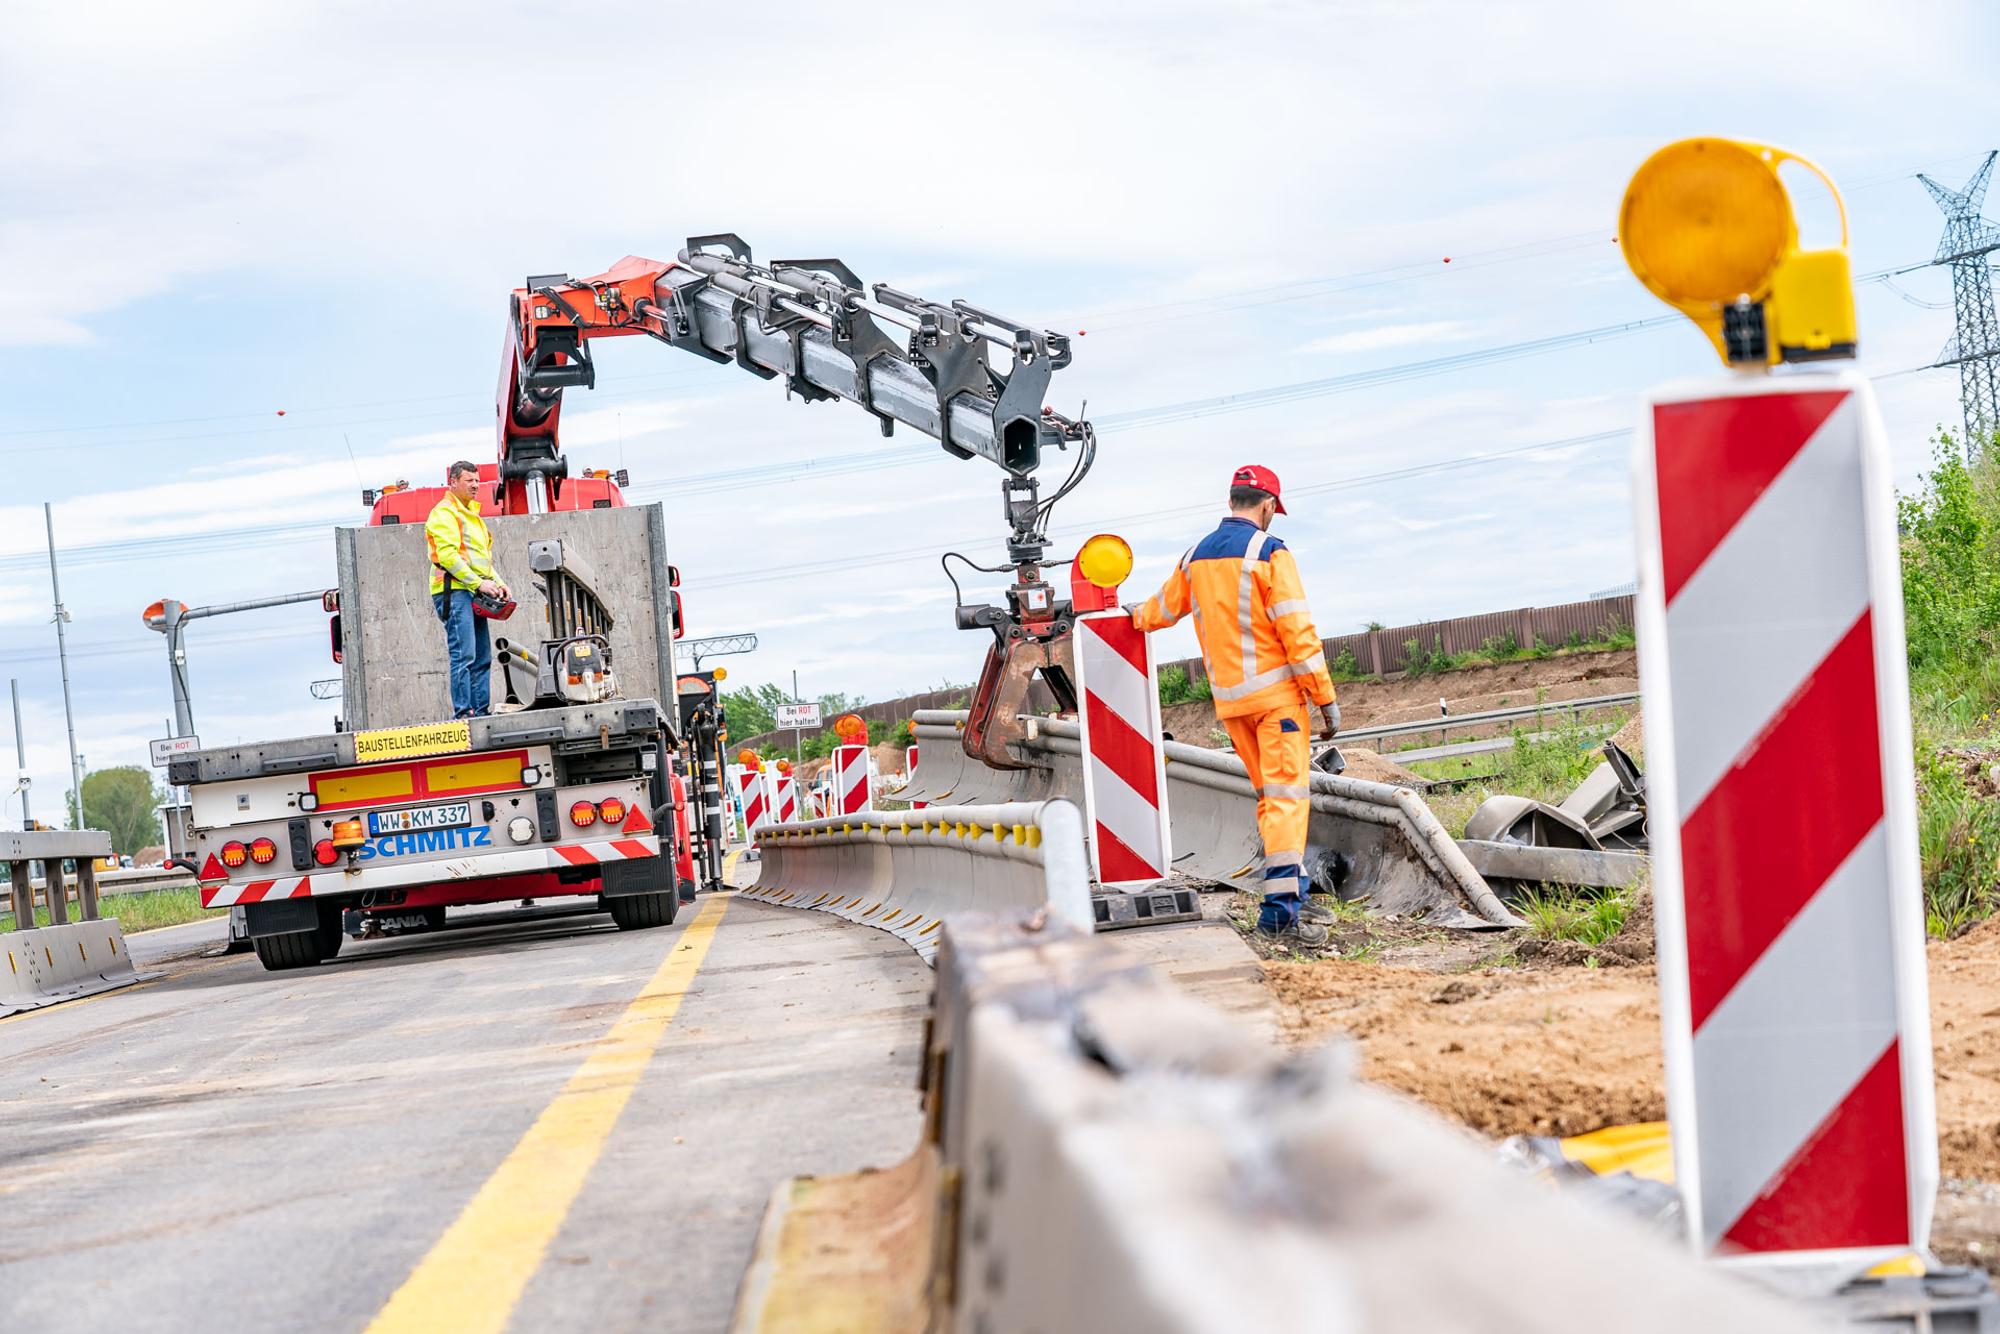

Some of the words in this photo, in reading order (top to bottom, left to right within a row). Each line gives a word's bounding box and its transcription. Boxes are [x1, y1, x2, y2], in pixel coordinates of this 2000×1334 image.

[786, 706, 797, 715] Bei
[798, 705, 812, 714] ROT
[794, 716, 819, 726] halten!
[175, 741, 190, 750] ROT
[357, 729, 468, 754] BAUSTELLENFAHRZEUG
[379, 813, 400, 831] WW
[411, 810, 433, 828] KM
[437, 805, 467, 824] 337
[358, 825, 492, 860] SCHMITZ
